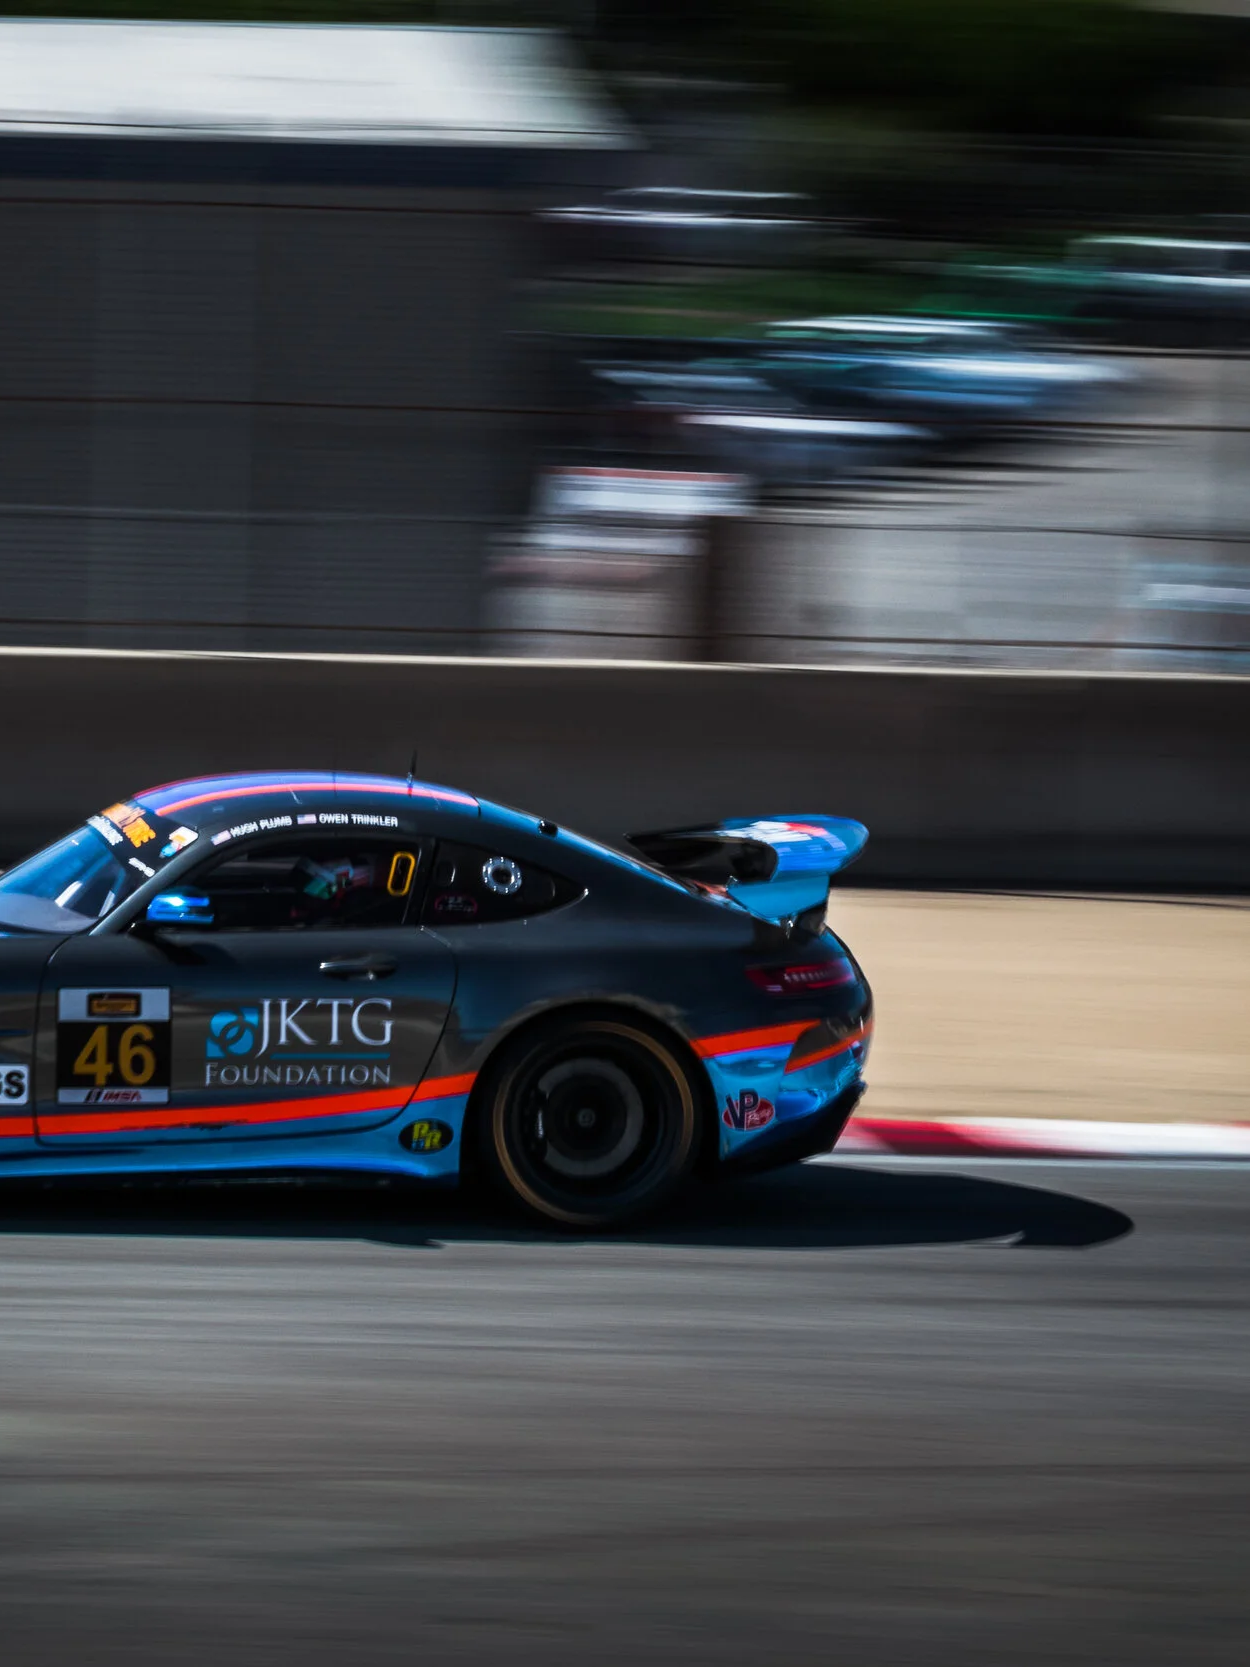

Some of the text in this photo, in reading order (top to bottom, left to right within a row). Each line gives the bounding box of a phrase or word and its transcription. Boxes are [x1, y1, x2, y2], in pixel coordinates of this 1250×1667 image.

[318, 813, 349, 825] OWEN
[254, 997, 395, 1060] JKTG
[73, 1024, 156, 1086] 46
[205, 1062, 391, 1088] FOUNDATION
[725, 1088, 760, 1131] VP
